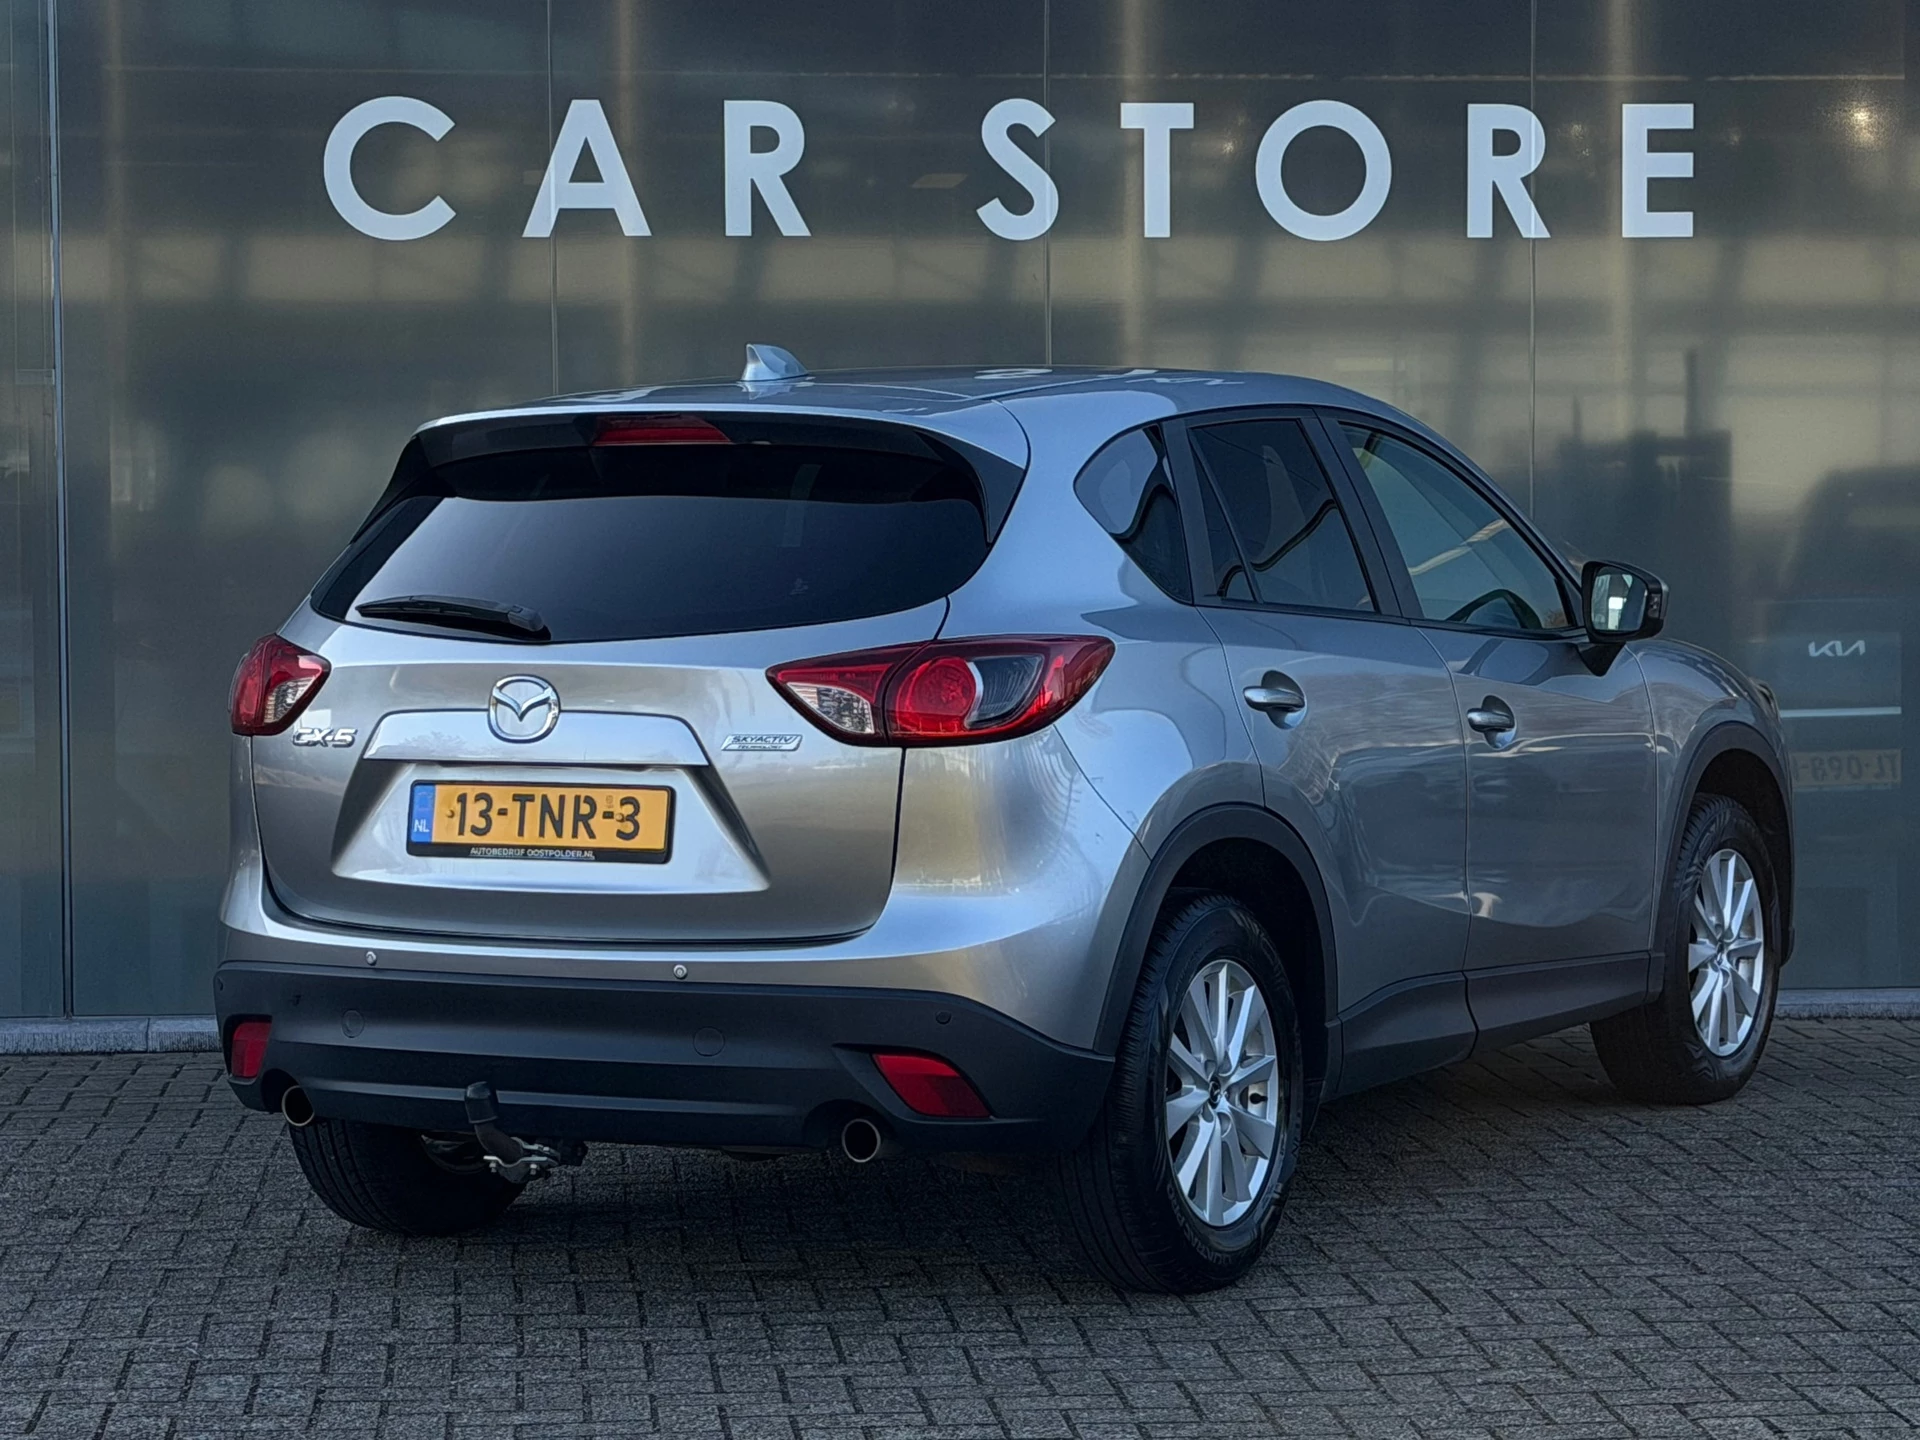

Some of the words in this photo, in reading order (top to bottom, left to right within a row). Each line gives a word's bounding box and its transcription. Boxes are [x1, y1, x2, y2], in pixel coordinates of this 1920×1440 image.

[323, 95, 812, 241] CAR
[976, 97, 1695, 242] STORE
[732, 735, 794, 743] SKYACTIV
[455, 792, 641, 841] 13-TNR-3
[413, 818, 430, 833] NL
[470, 847, 525, 857] AUTOBEDRIJF
